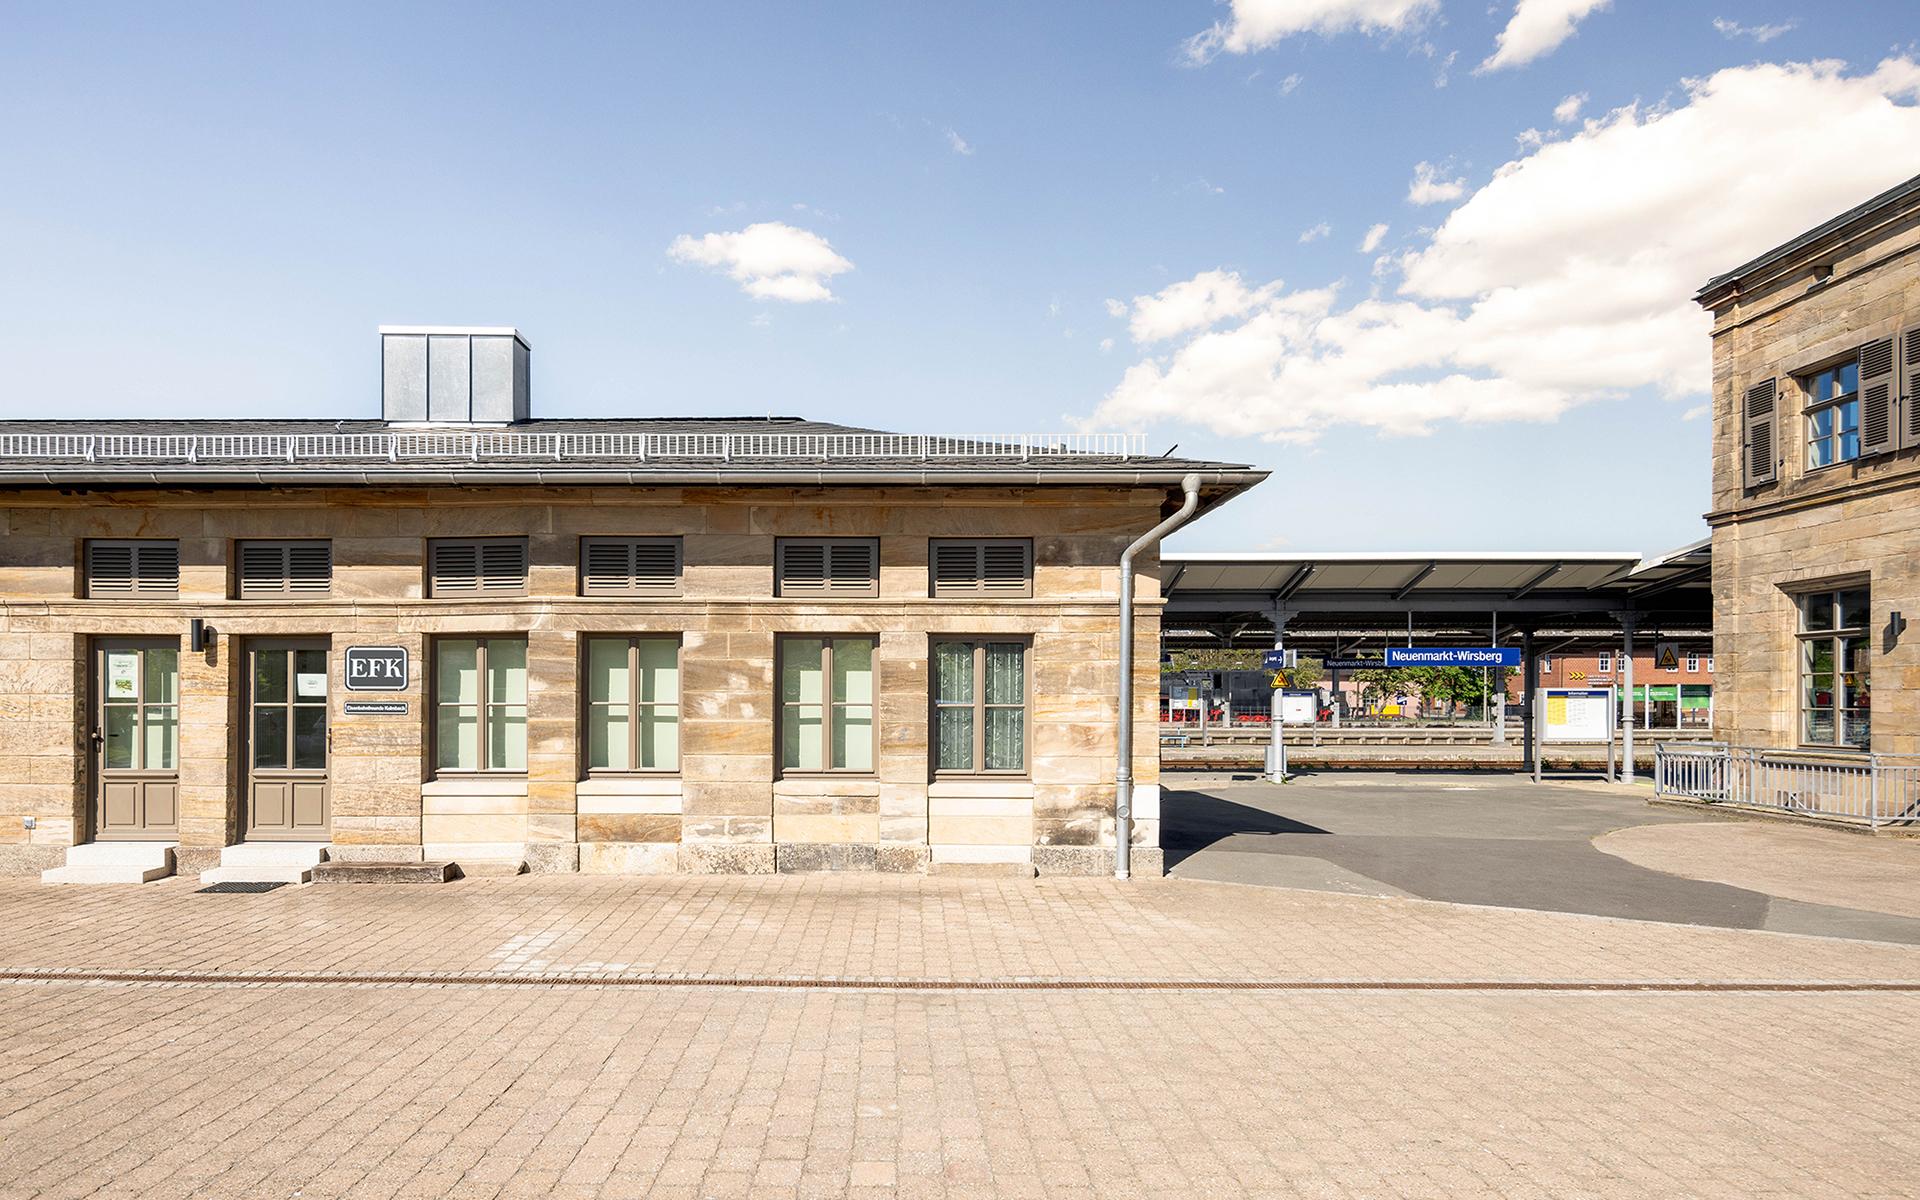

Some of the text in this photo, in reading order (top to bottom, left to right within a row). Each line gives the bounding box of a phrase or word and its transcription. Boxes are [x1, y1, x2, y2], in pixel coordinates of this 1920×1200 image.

[1327, 659, 1385, 667] Neuenmarkt-Wirsbe
[1392, 650, 1502, 663] Neuenmarkt-Wirsberg
[350, 658, 403, 678] EFK
